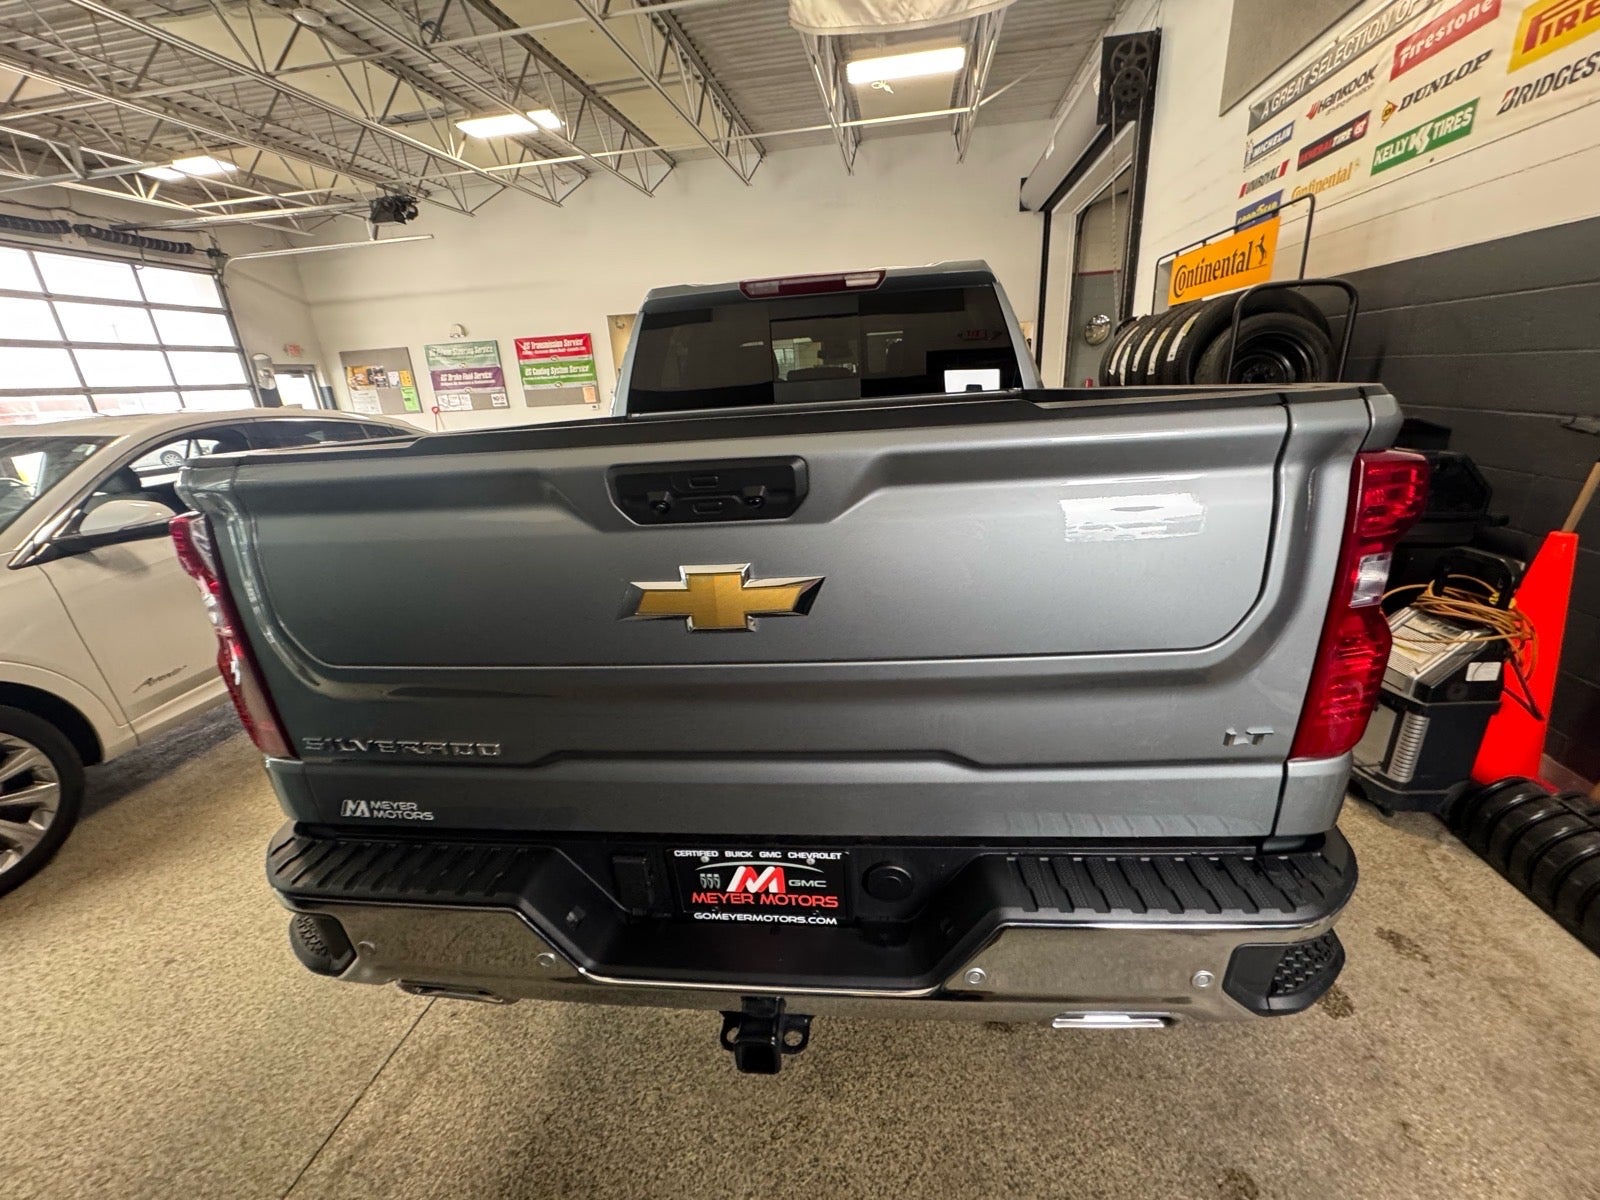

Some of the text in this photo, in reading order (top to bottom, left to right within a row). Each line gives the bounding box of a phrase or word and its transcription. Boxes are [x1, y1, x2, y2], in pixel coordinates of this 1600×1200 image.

[1399, 0, 1494, 68] Firestone
[1260, 103, 1270, 120] A
[1271, 73, 1310, 112] GREAT
[1309, 15, 1390, 85] SELECTION
[1397, 49, 1493, 112] DUNLOP
[1496, 51, 1600, 116] BRIDGES
[1252, 124, 1293, 160] MICHELIN
[1373, 135, 1410, 167] KELLY
[1432, 106, 1474, 141] TIRES
[1174, 241, 1253, 298] Continental
[563, 338, 584, 347] Service
[302, 737, 500, 756] SILVERADO
[1223, 727, 1275, 747] LT
[370, 800, 418, 811] MEYER
[373, 810, 434, 821] MOTORS
[674, 850, 842, 860] CERTIFIED BUICK GMC CHEVROLET
[788, 879, 827, 888] GMC
[692, 892, 839, 908] MEYER MOTORS
[694, 912, 837, 925] GOMEYERMOTORS.COM
